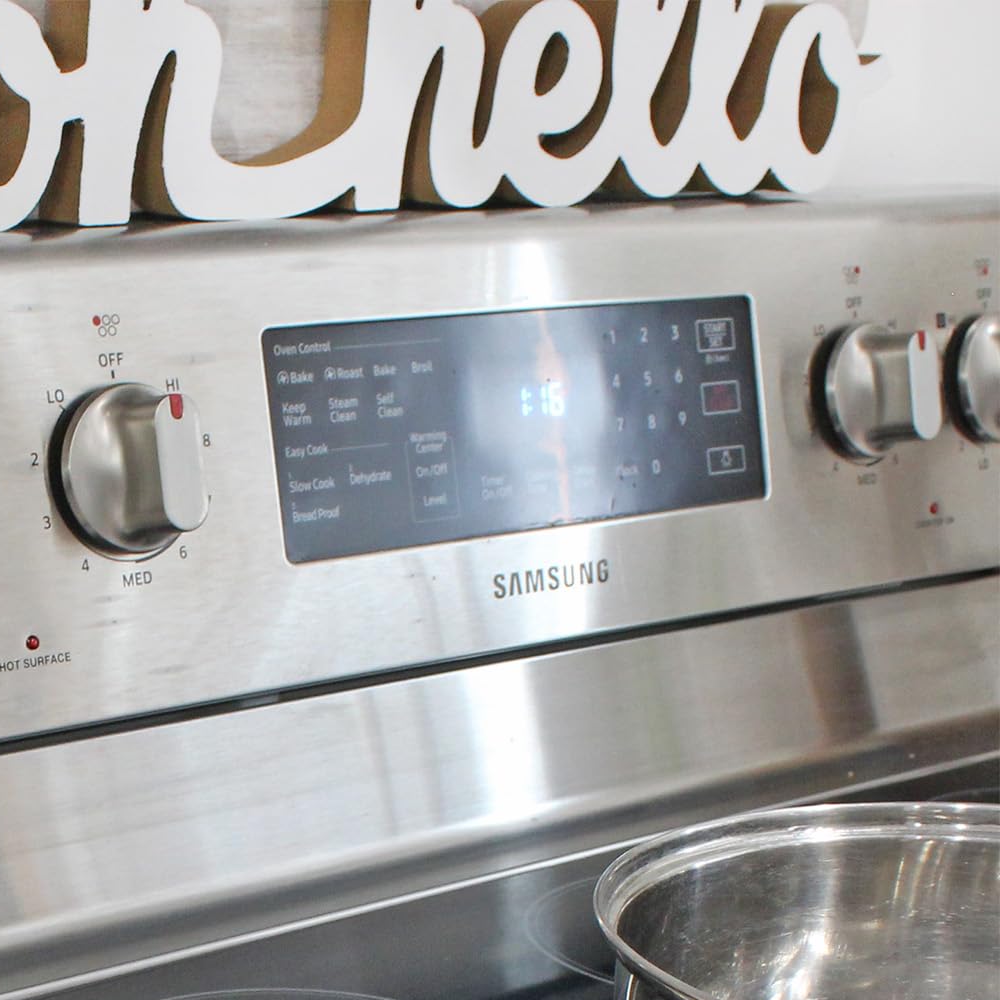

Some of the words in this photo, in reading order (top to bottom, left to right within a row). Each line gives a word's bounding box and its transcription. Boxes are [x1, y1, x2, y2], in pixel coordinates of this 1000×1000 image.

[608, 329, 617, 344] 1
[639, 326, 649, 343] 2
[671, 324, 681, 340] 3
[273, 344, 297, 356] Oven
[298, 340, 332, 354] Control
[98, 352, 124, 368] OFF
[289, 371, 315, 384] Bake
[337, 366, 364, 380] Roast
[373, 364, 397, 377] Bake
[411, 361, 433, 373] Broil
[643, 370, 653, 387] 5
[675, 370, 684, 384] 6
[165, 377, 180, 393] HI
[612, 373, 621, 388] 4
[47, 389, 65, 404] LO
[328, 397, 359, 410] Steam
[376, 392, 395, 405] Self
[282, 401, 308, 414] Keep
[377, 406, 403, 418] Clean
[283, 414, 312, 426] Warm
[330, 410, 357, 423] Clean
[617, 416, 625, 432] 7
[647, 413, 657, 430] 8
[678, 411, 688, 426] 9
[202, 434, 211, 448] 8
[285, 446, 305, 458] Easy
[307, 444, 329, 456] Cook
[30, 452, 39, 467] 2
[652, 459, 662, 475] 0
[289, 480, 311, 493] Slow
[312, 476, 336, 490] Cook
[42, 515, 51, 530] 3
[179, 545, 188, 559] 6
[81, 559, 89, 572] 4
[122, 571, 152, 588] MED
[493, 557, 610, 599] SAMSUNG
[23, 651, 72, 669] SURFACE
